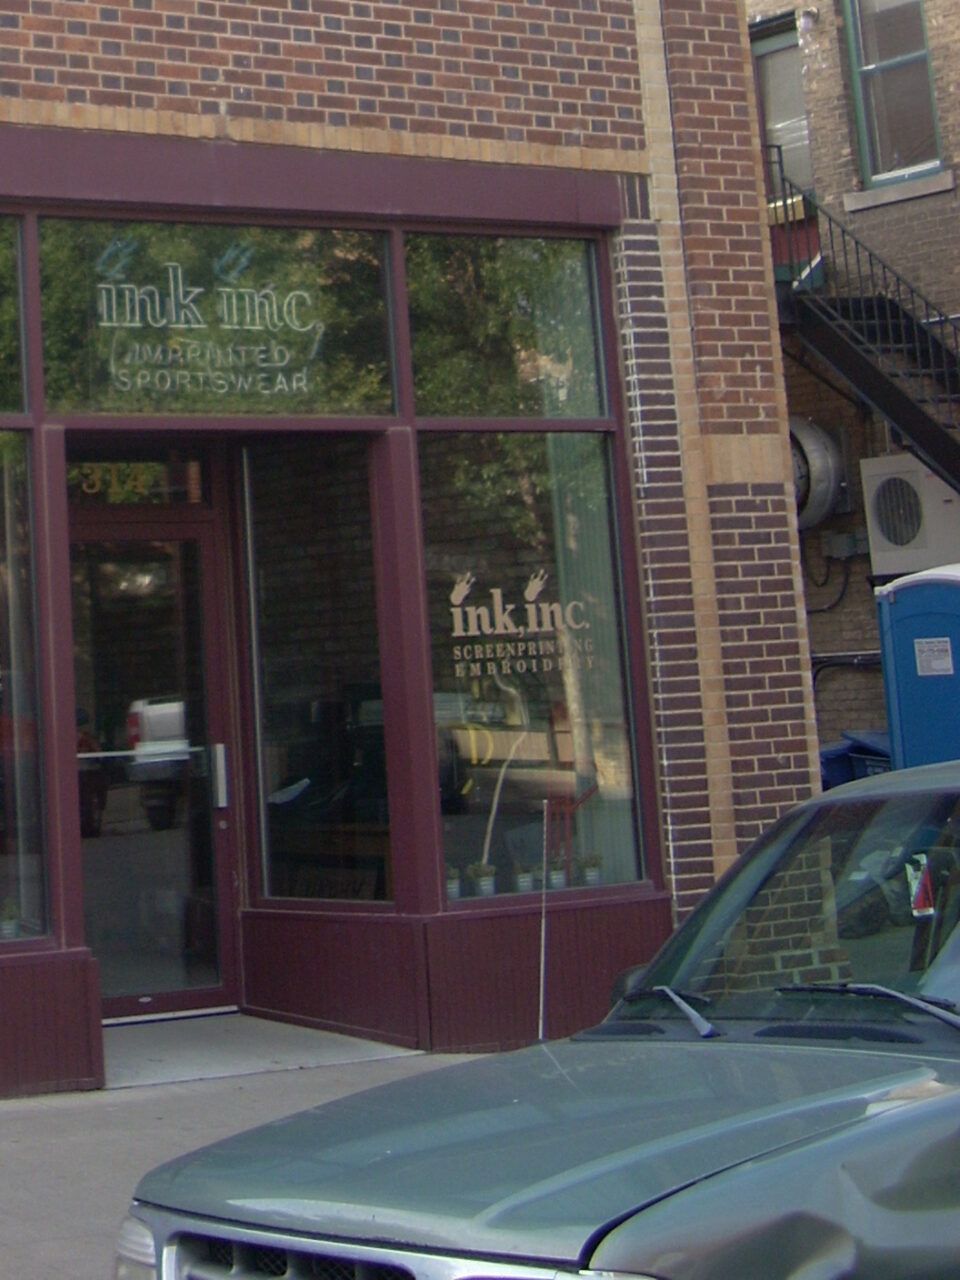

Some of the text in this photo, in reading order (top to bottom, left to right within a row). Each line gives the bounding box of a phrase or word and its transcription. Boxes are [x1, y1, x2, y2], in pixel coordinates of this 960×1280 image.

[97, 249, 208, 329] ink
[124, 339, 290, 368] IMPRINTED
[114, 368, 308, 394] SPORTSWEAR
